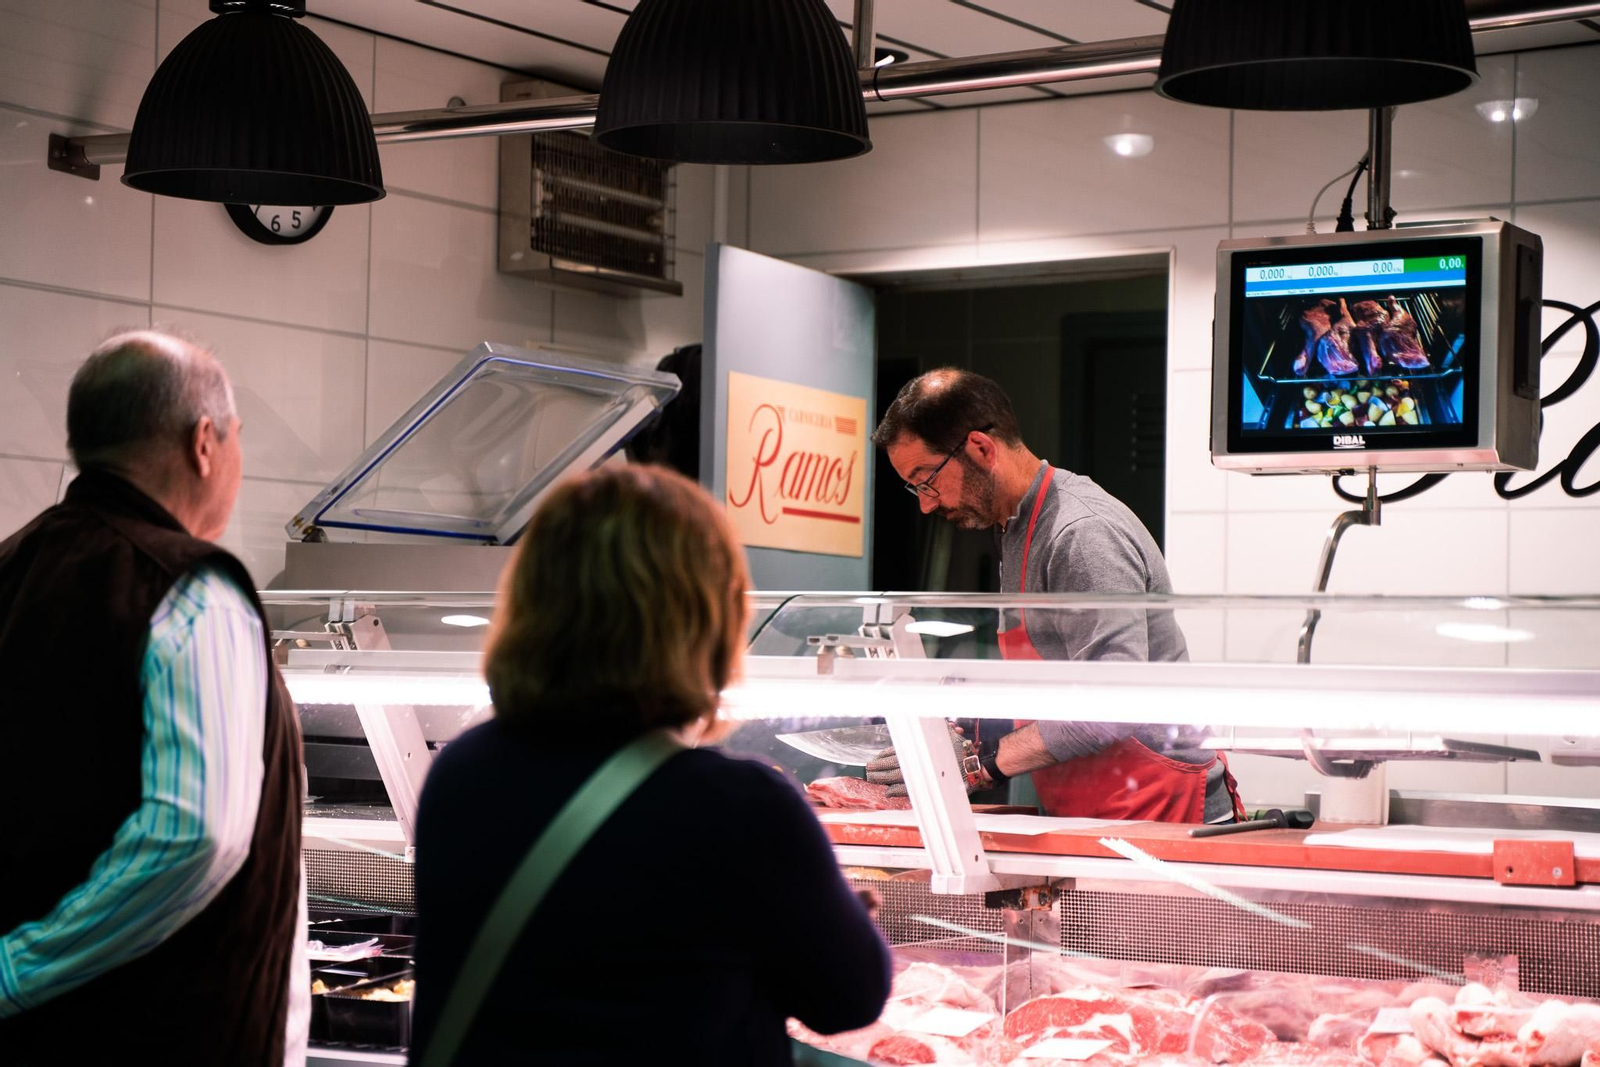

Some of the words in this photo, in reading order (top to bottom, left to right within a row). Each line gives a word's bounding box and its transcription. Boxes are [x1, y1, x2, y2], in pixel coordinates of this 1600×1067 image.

[271, 214, 281, 232] 6
[291, 211, 302, 229] 5
[1260, 268, 1285, 280] 0,000
[1308, 265, 1334, 278] 0,000
[1373, 262, 1393, 274] 0,00
[1439, 257, 1462, 271] 0,00
[1333, 435, 1366, 446] DIBAL
[729, 403, 858, 525] Ramos
